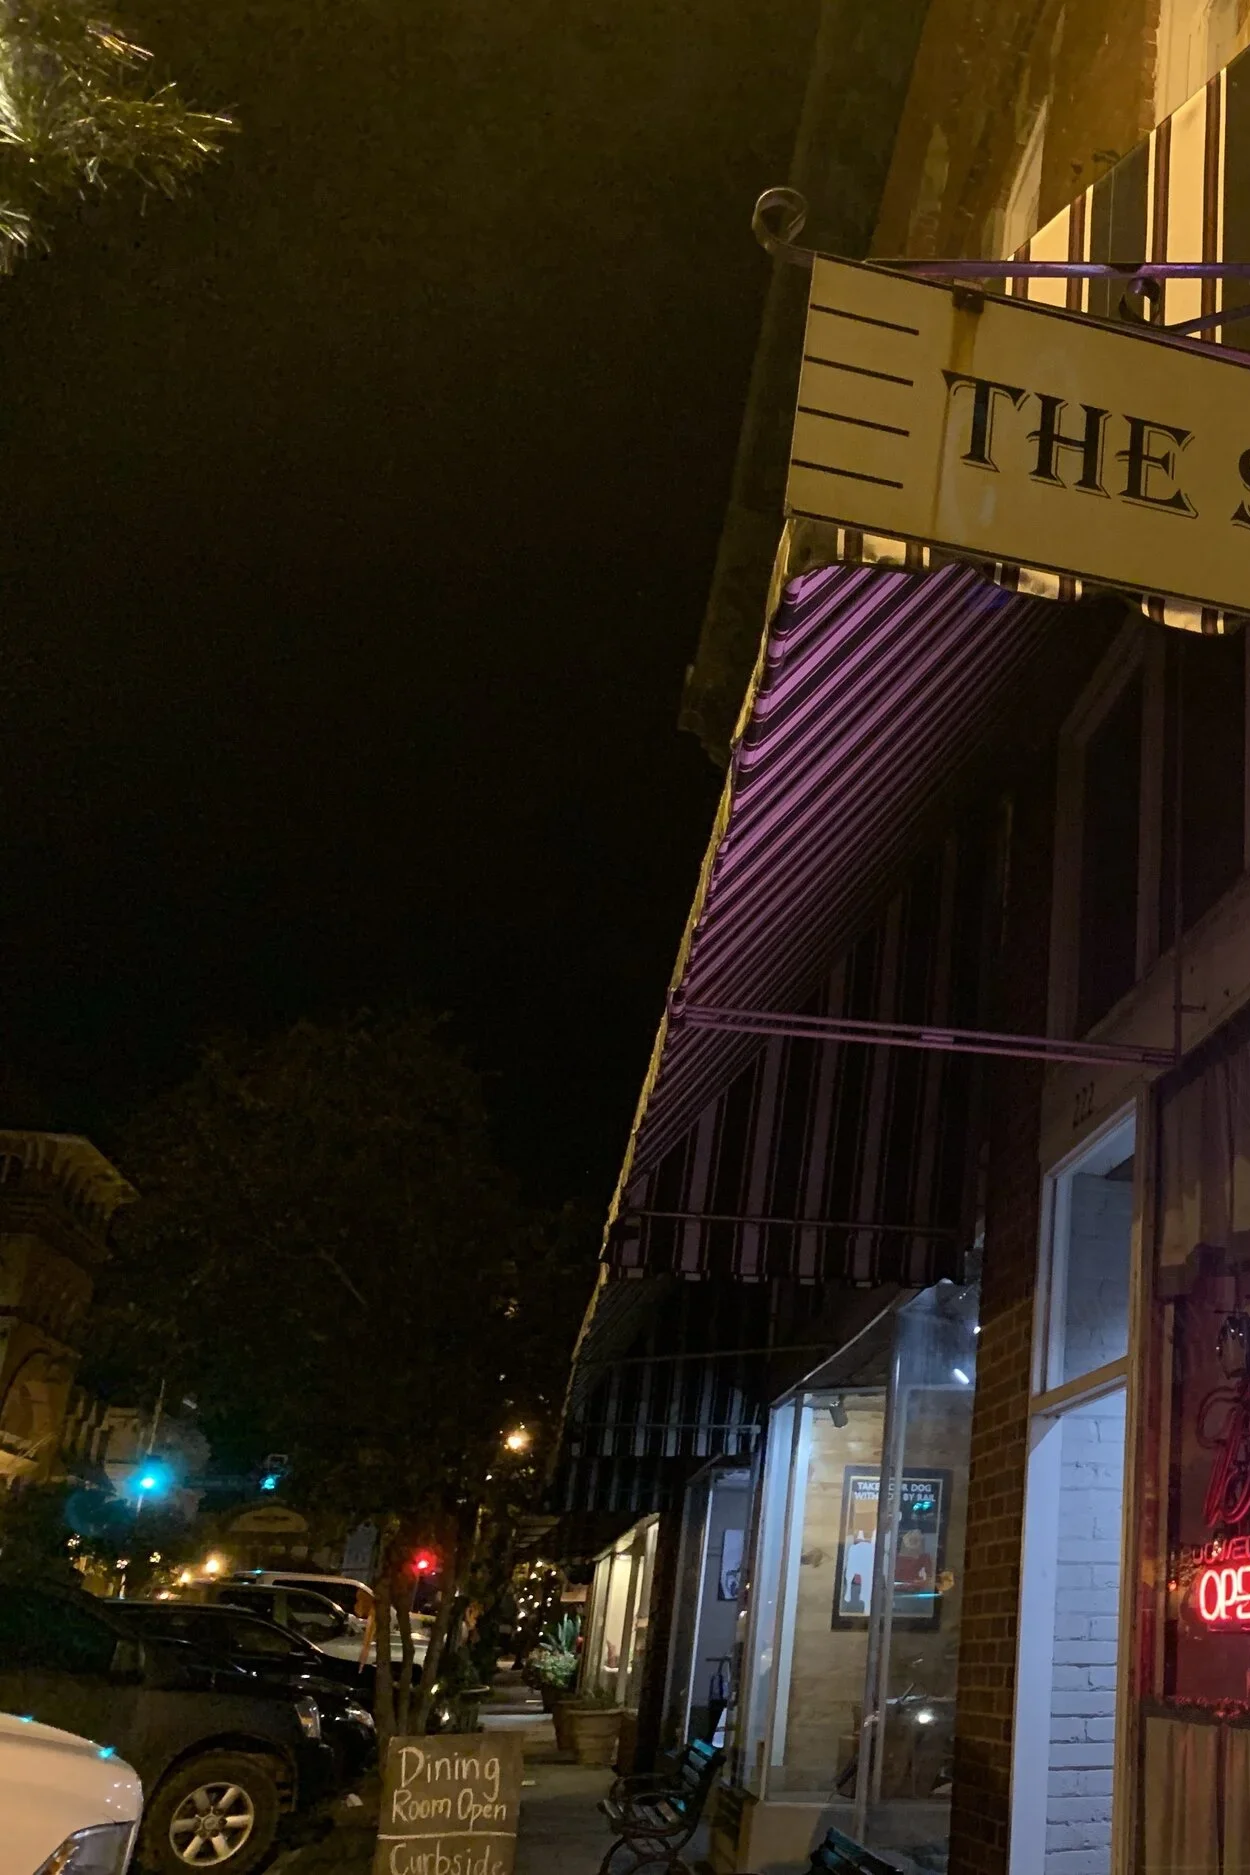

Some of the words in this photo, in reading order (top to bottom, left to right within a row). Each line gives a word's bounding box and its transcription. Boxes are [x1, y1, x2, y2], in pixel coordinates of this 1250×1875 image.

[940, 369, 1199, 518] THE
[854, 1491, 879, 1501] WITH
[903, 1493, 915, 1501] BY
[917, 1494, 936, 1502] RAIL
[857, 1481, 880, 1491] TAKE
[911, 1483, 932, 1492] DOG
[398, 1746, 500, 1801] Dining
[391, 1788, 451, 1824] Room
[457, 1788, 507, 1831] Open
[389, 1840, 506, 1875] Curbside
